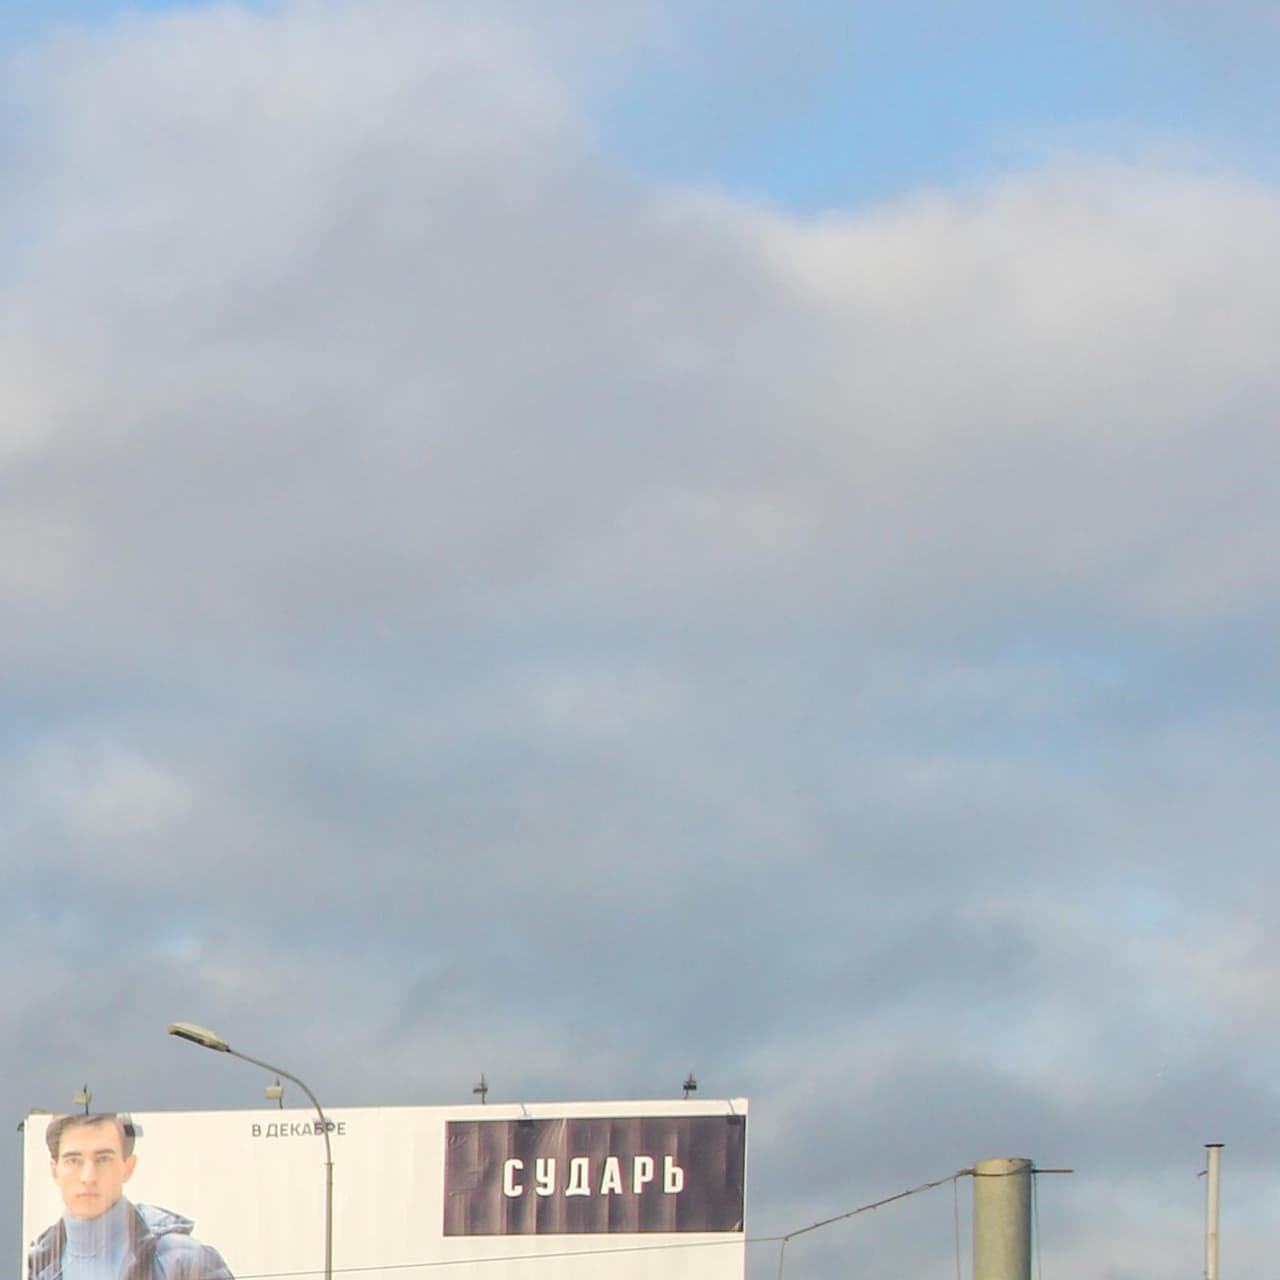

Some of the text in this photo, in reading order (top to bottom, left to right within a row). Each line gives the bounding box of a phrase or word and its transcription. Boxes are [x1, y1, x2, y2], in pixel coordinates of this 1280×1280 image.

[251, 1121, 347, 1139] В ДЕКАБРЕ
[503, 1155, 685, 1198] СУДАРЬ
